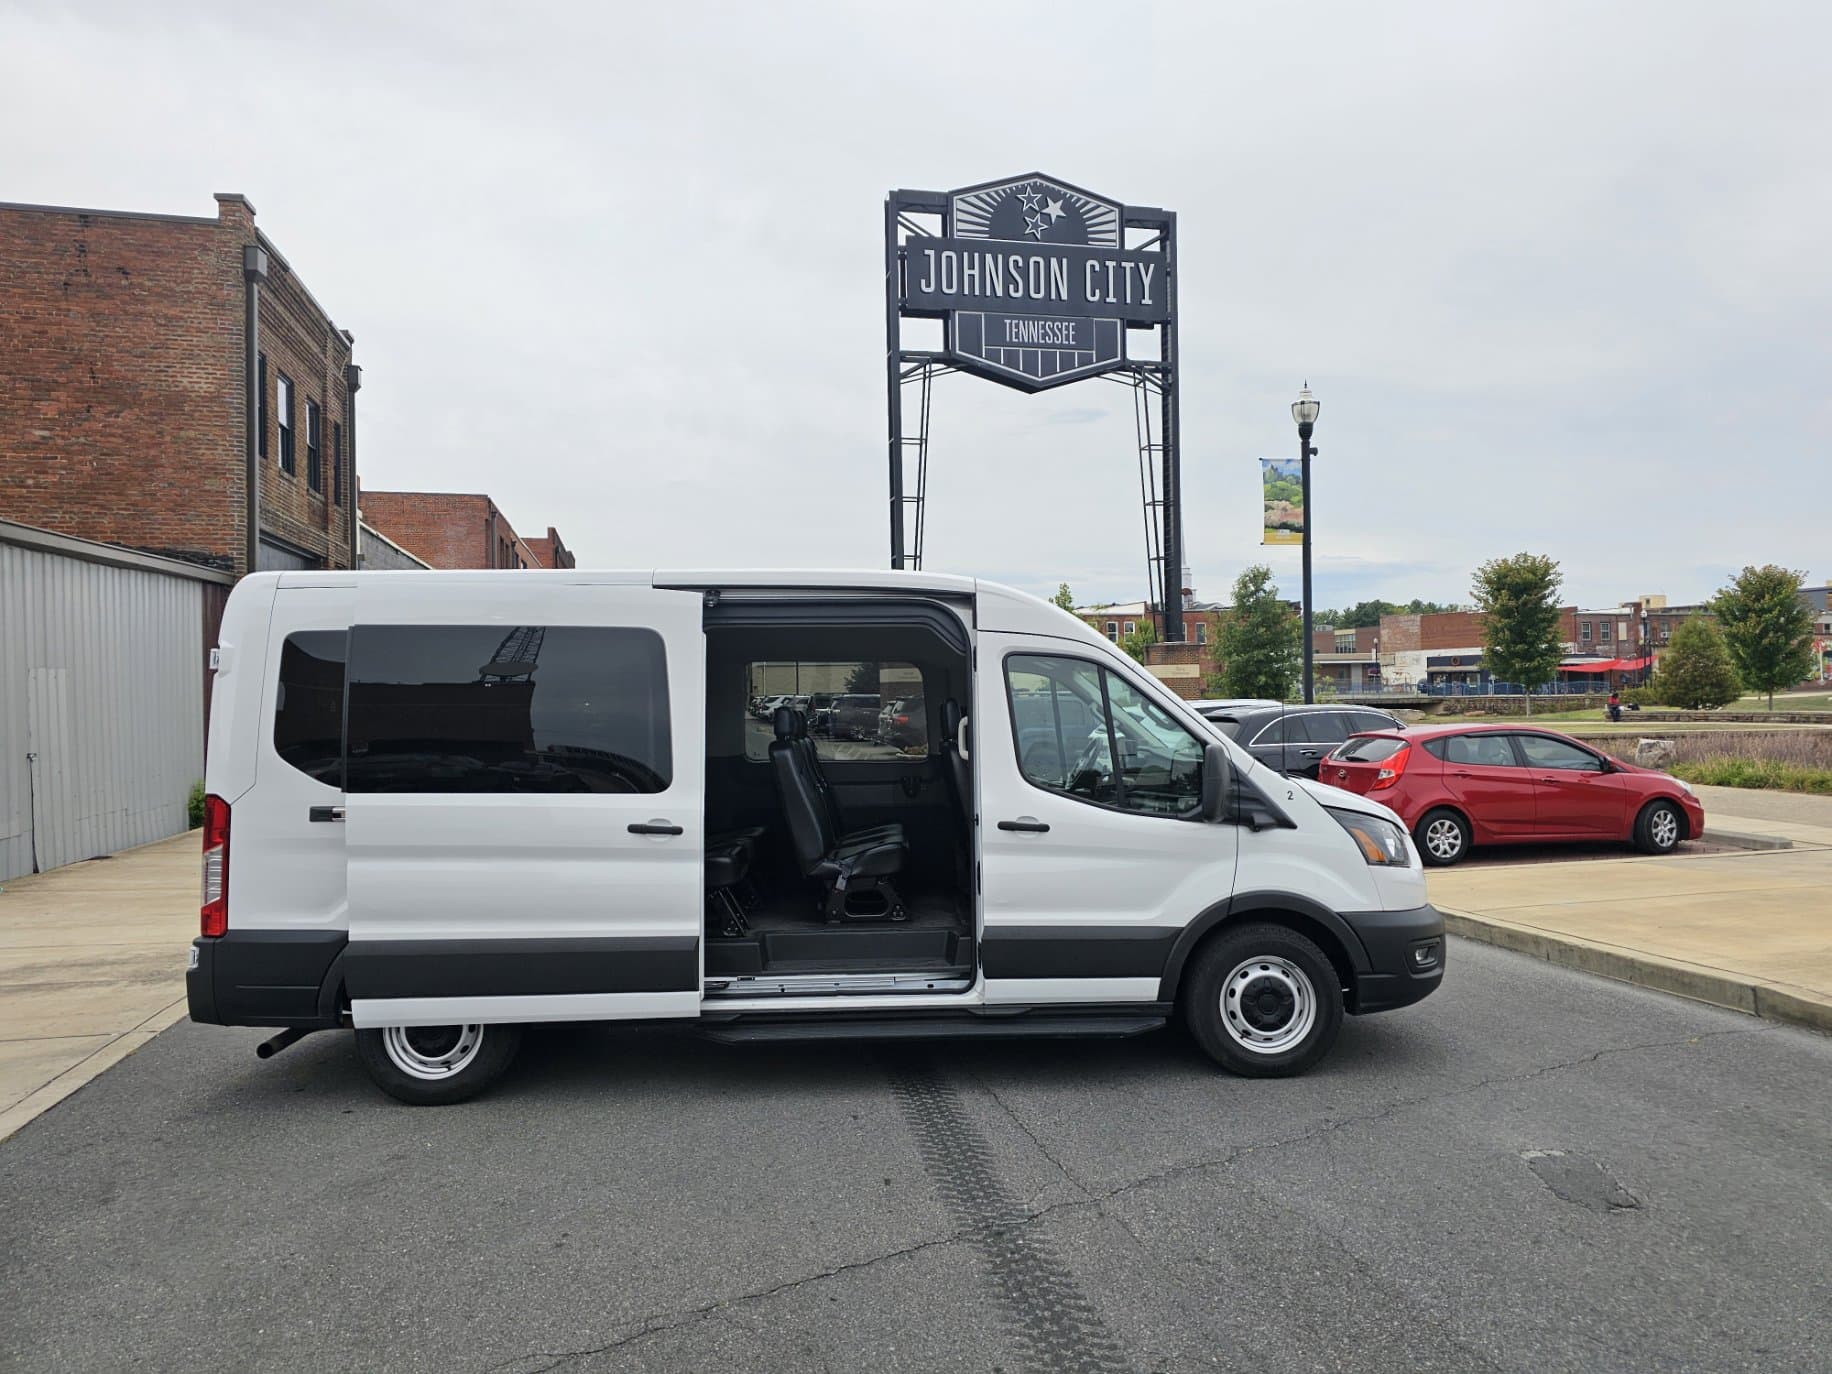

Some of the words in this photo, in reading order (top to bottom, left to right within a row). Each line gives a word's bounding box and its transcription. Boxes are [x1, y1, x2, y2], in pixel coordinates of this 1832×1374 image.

[920, 249, 1068, 301] JOHNSON
[1086, 259, 1155, 304] CITY
[1004, 319, 1076, 344] TENNESSEE
[1286, 790, 1294, 801] 2
